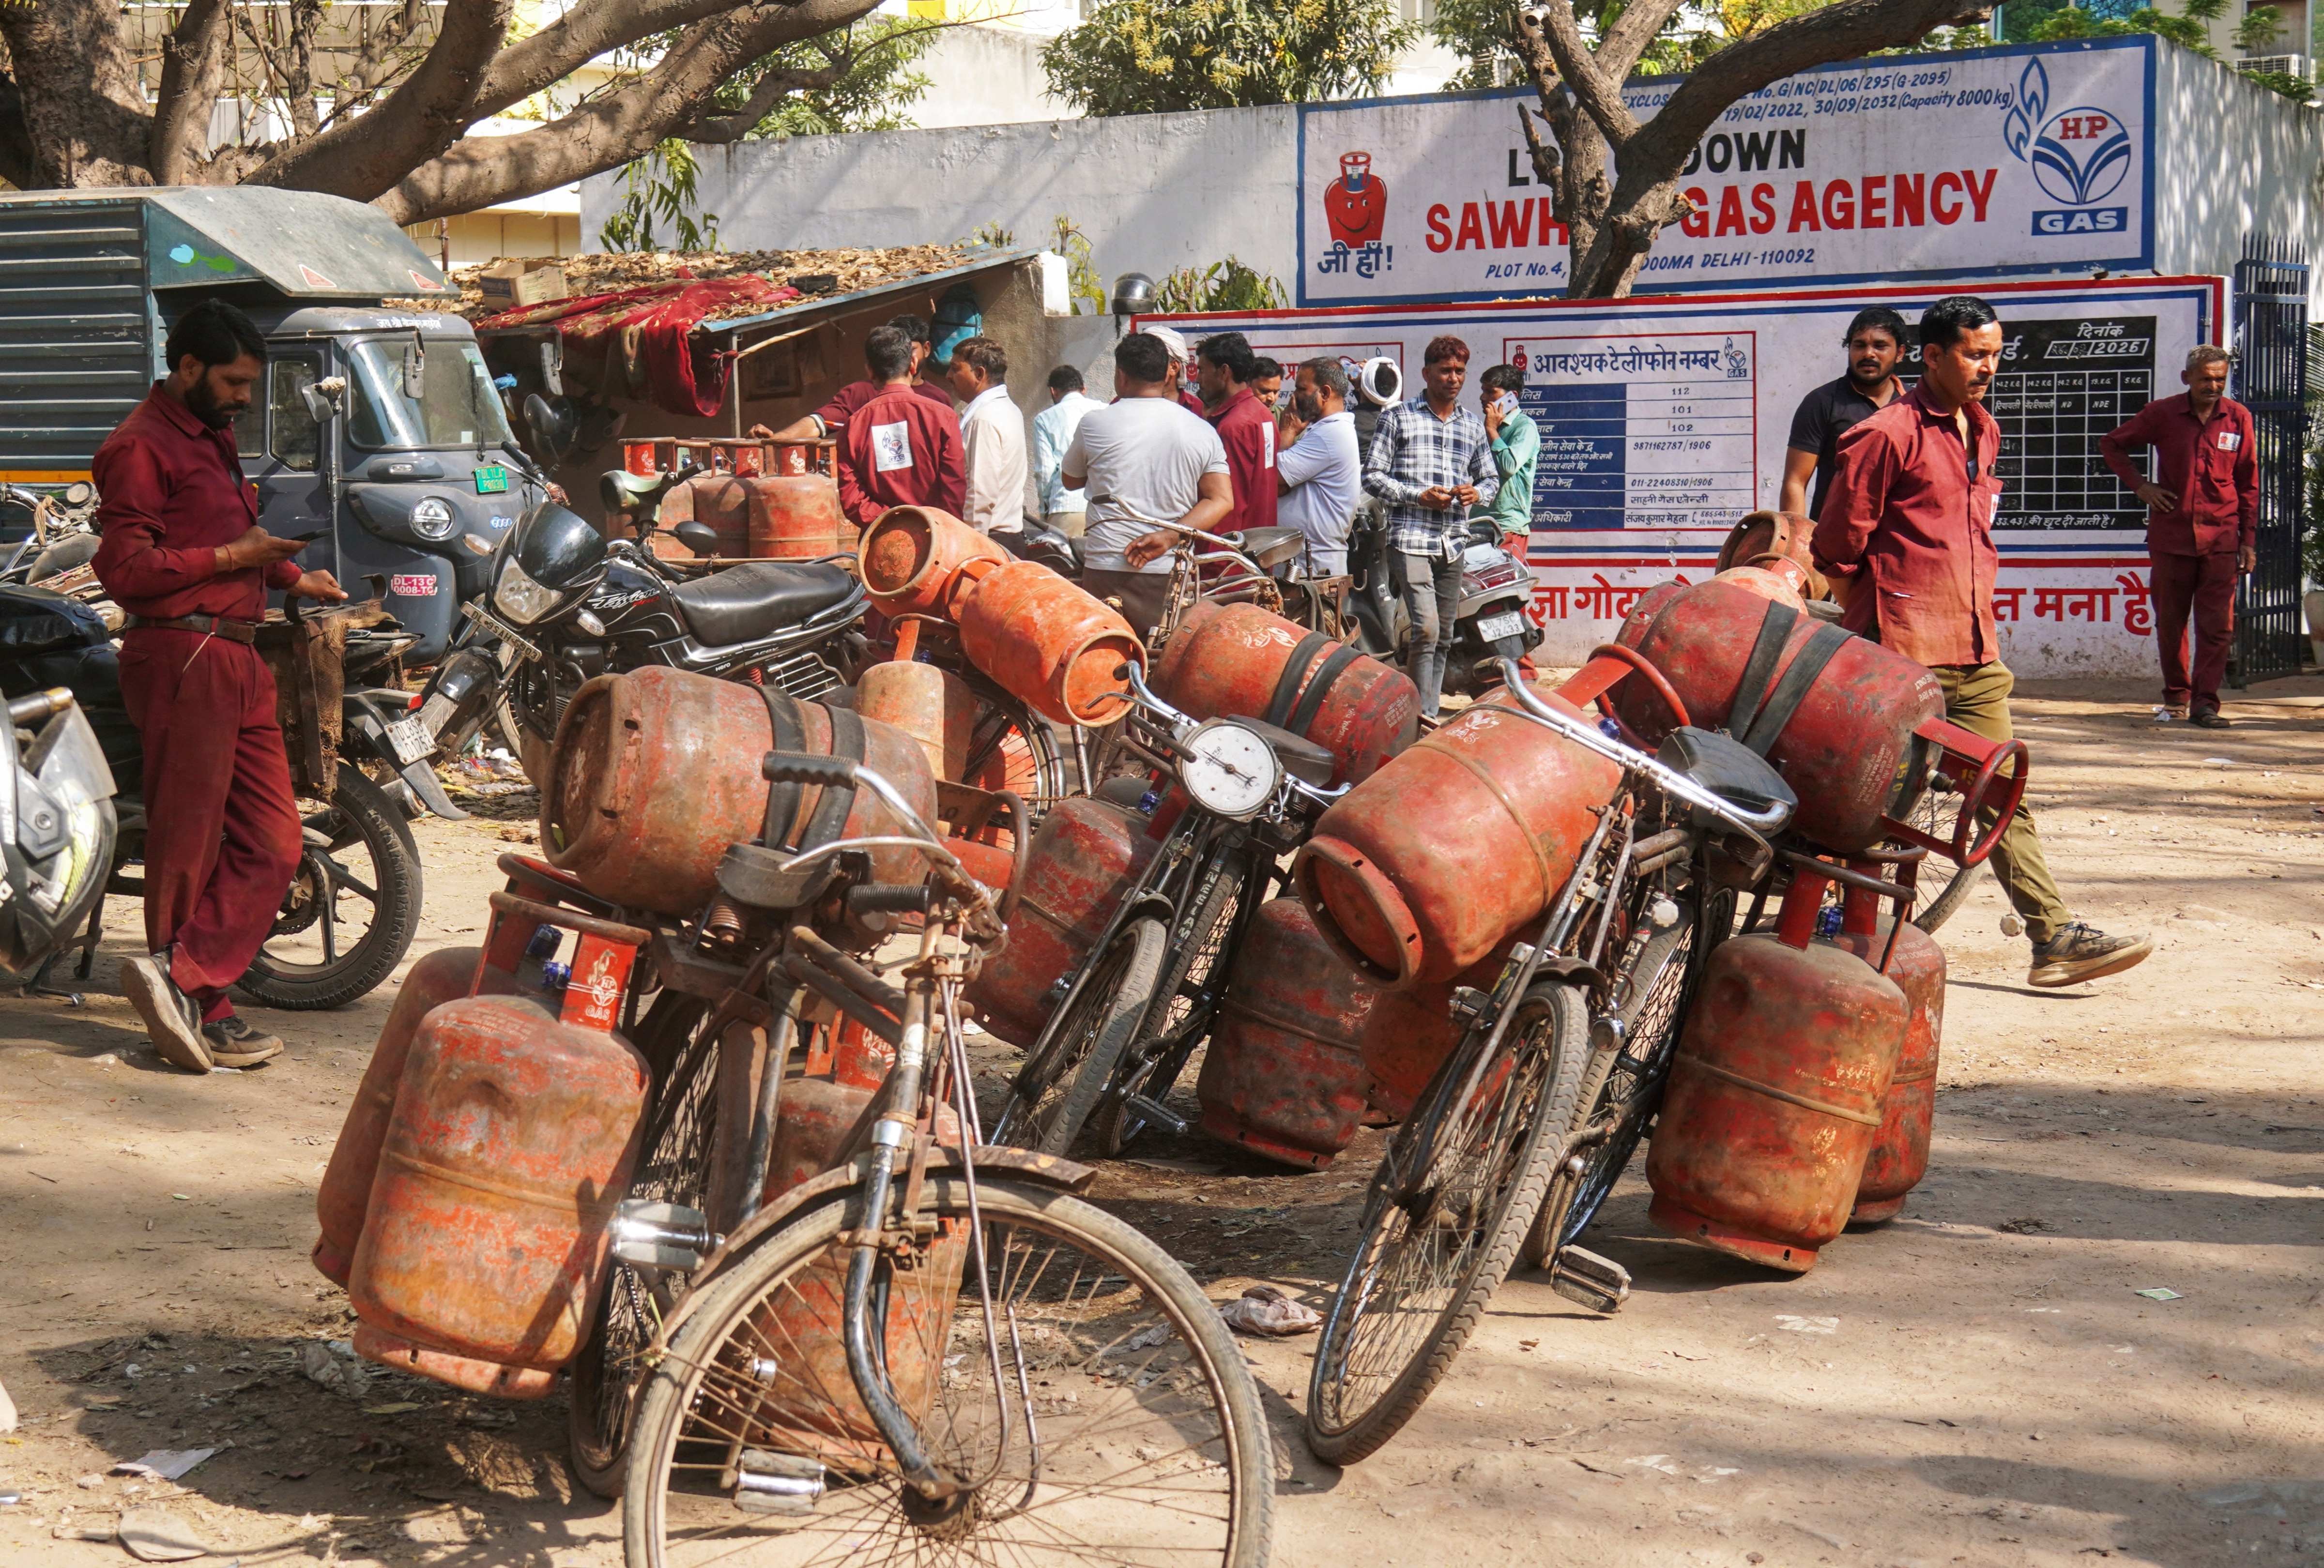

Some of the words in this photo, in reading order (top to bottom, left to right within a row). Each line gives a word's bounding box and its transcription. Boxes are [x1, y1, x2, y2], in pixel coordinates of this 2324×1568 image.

[2059, 116, 2108, 140] HP
[1680, 182, 1776, 238] GAS
[1787, 168, 1998, 233] AGENCY
[2039, 210, 2118, 233] GAS
[1317, 242, 1351, 274] जी
[1485, 263, 1522, 278] PLOT
[2077, 322, 2125, 338] दिनांक
[1534, 353, 1607, 376] आवश्यक
[1679, 350, 1722, 371] नम्बर
[2092, 400, 2110, 409] NDE
[2033, 588, 2119, 622] मना
[2115, 571, 2153, 636] है
[471, 611, 482, 624] DL
[1485, 613, 1515, 630] DL7SC
[715, 662, 731, 672] Hero
[395, 716, 424, 742] DL8SB
[600, 978, 616, 990] HP
[585, 1005, 611, 1021] GAS
